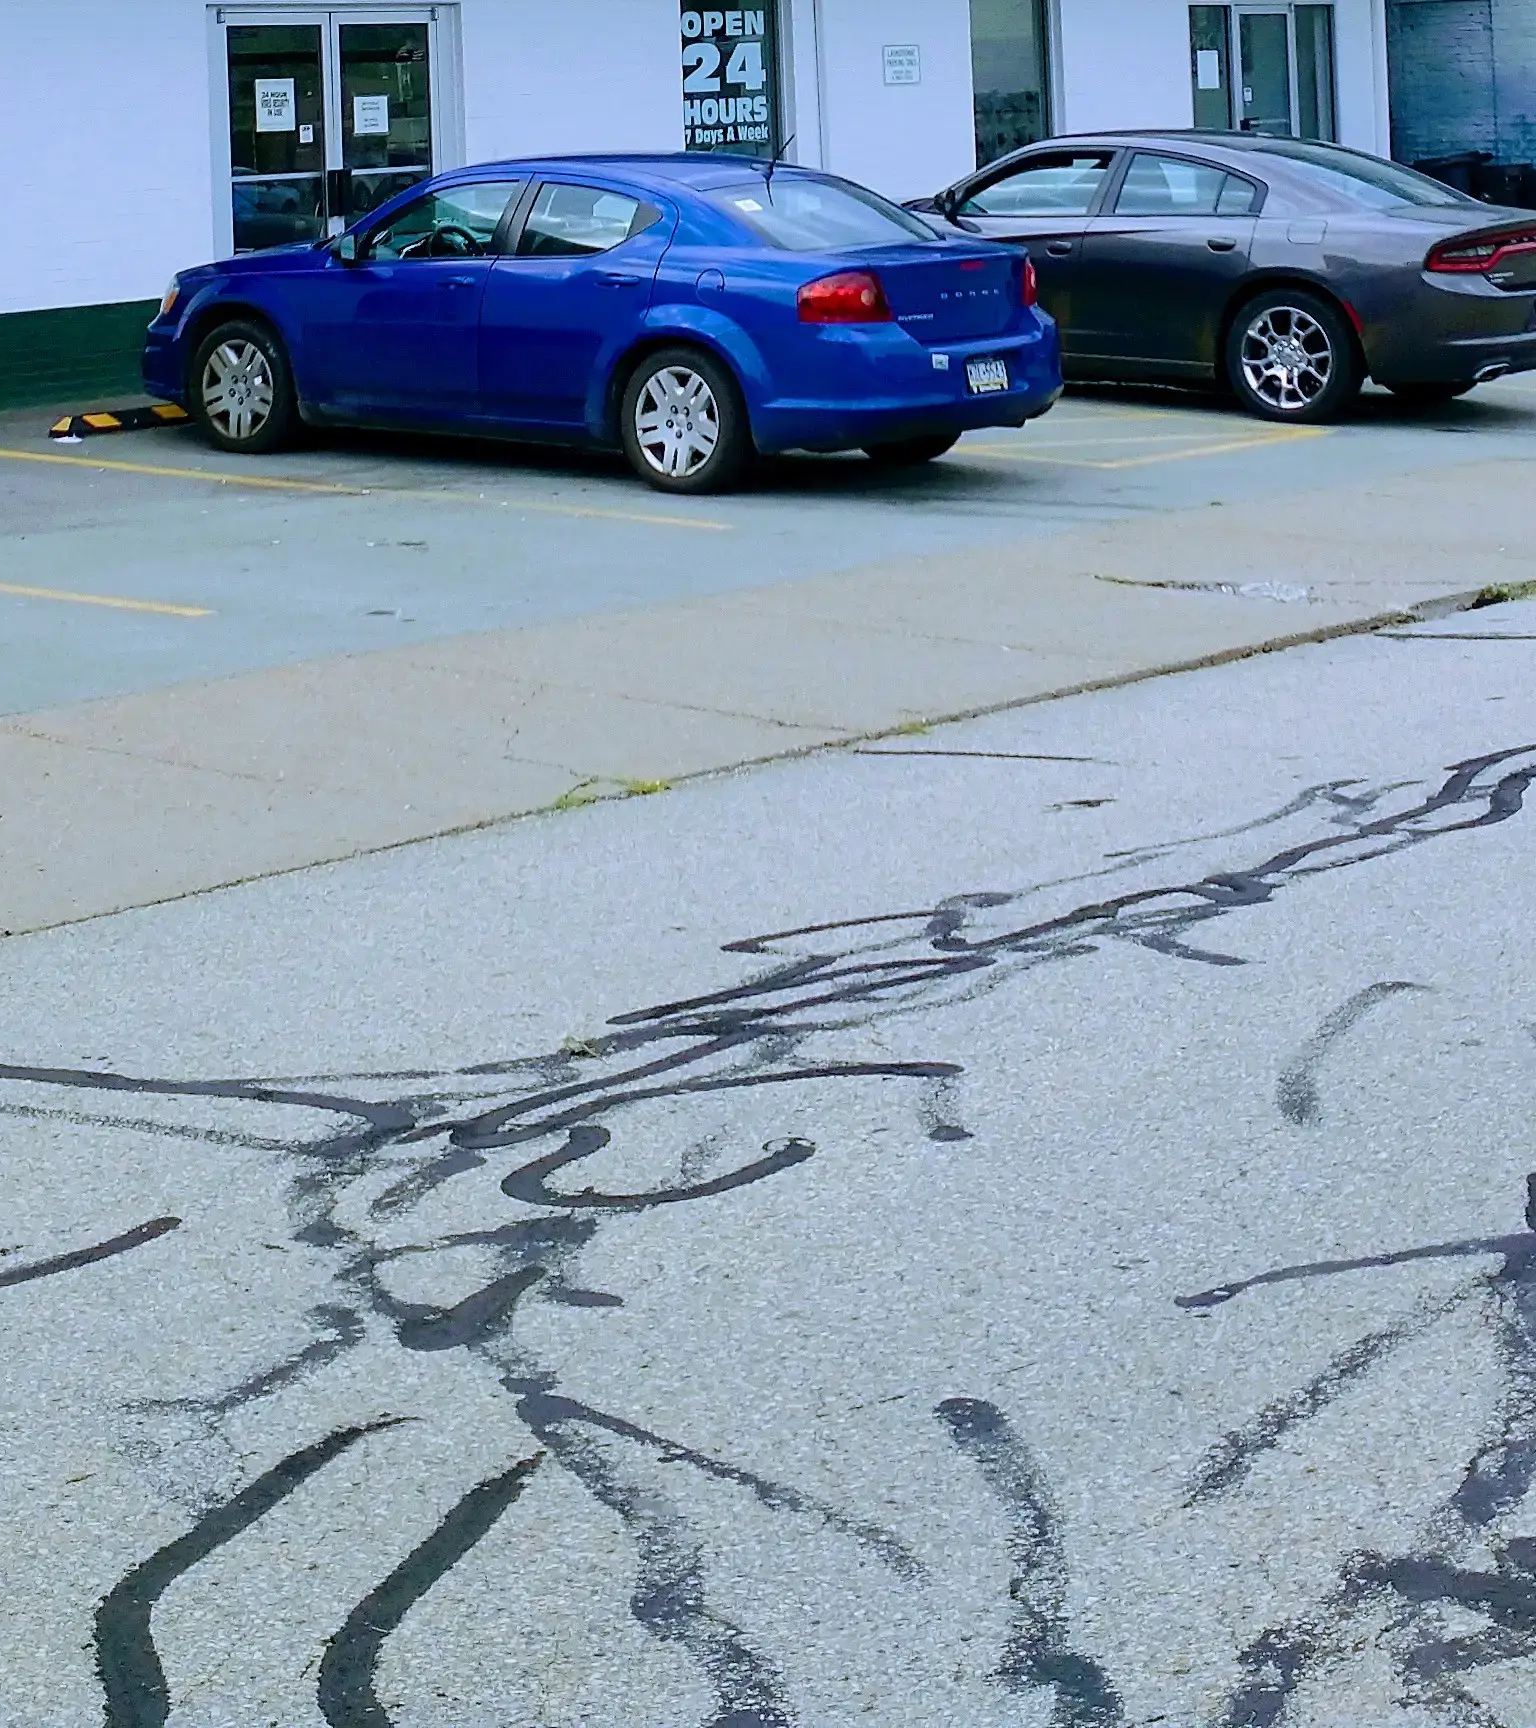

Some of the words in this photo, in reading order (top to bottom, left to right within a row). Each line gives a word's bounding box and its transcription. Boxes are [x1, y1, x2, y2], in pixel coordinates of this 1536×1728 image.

[681, 10, 765, 38] OPEN
[682, 41, 767, 93] 24
[683, 95, 768, 125] HOURS
[685, 128, 692, 145] 7
[694, 127, 724, 145] Days
[726, 125, 736, 142] A
[737, 122, 769, 141] Week
